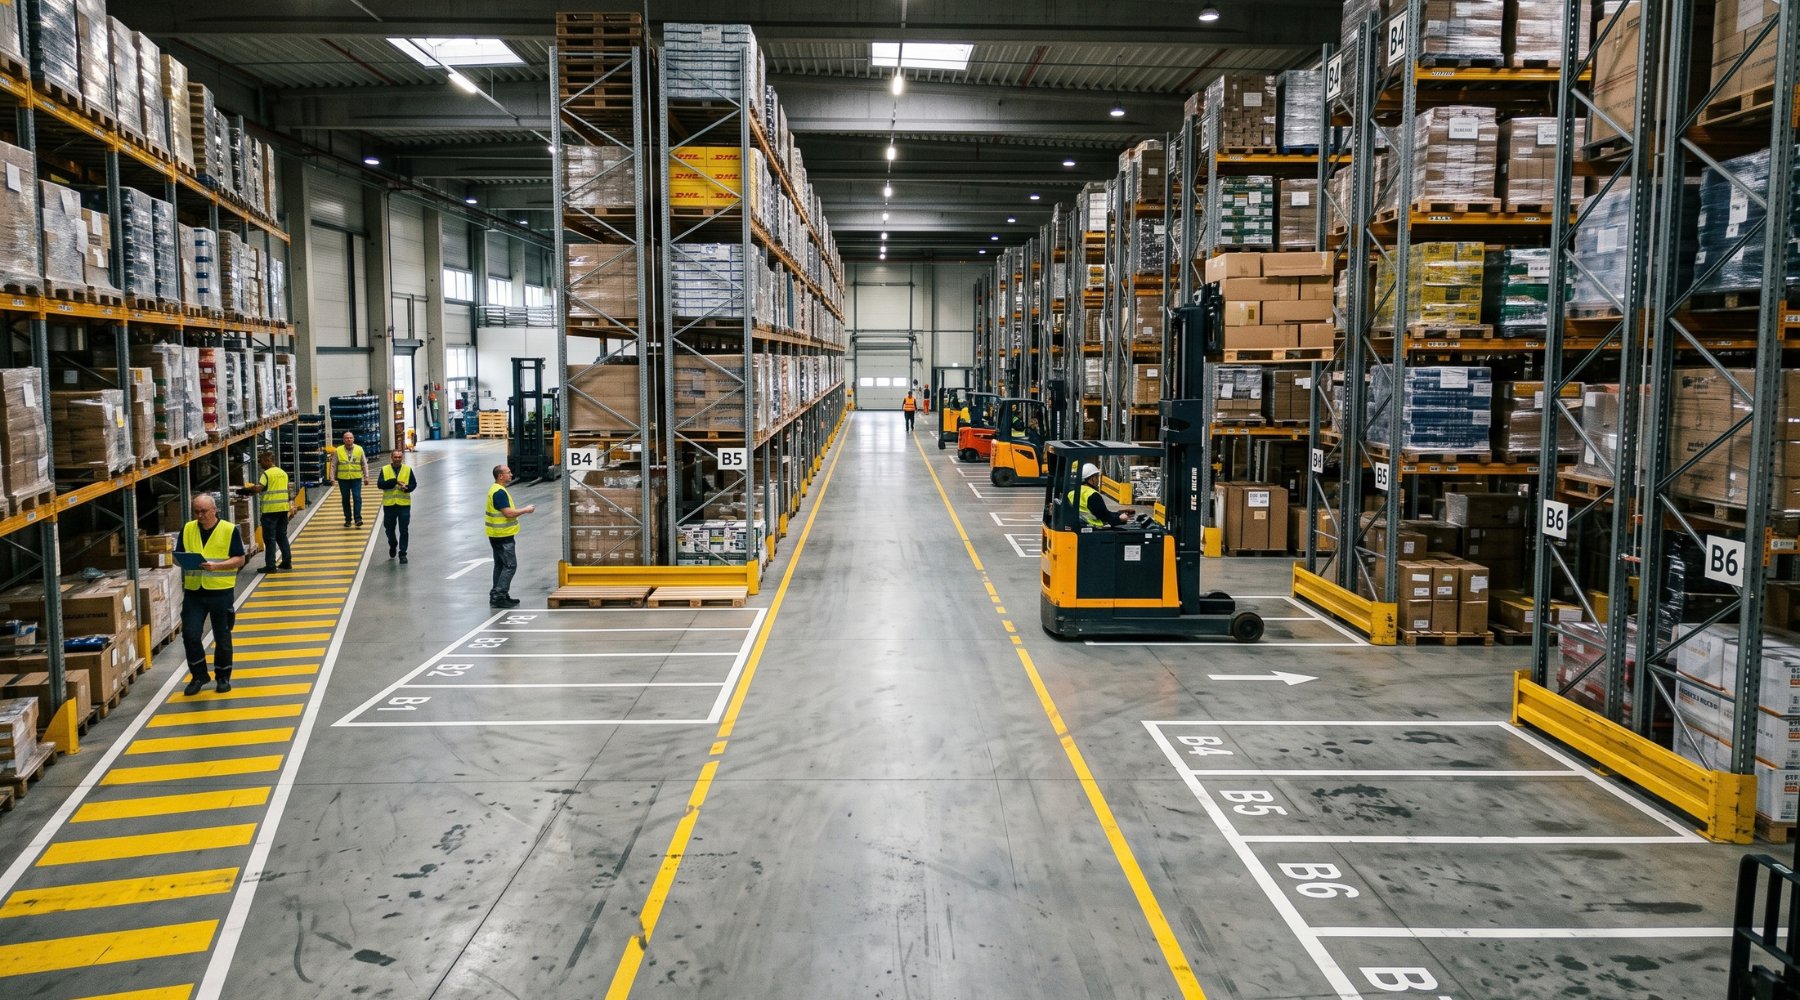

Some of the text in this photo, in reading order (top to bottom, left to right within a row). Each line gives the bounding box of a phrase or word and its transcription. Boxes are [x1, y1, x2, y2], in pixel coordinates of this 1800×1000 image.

[1391, 20, 1404, 55] B4
[1328, 63, 1339, 94] B4
[571, 453, 592, 466] B4
[722, 453, 742, 466] B5
[1377, 468, 1387, 485] B5
[1546, 507, 1564, 530] B6
[1711, 545, 1738, 576] B6
[467, 638, 510, 648] B3
[426, 664, 475, 677] B2
[376, 697, 432, 711] B1
[1176, 735, 1234, 757] B4
[1218, 790, 1288, 817] B5
[1277, 862, 1360, 900] B6
[1359, 967, 1453, 1000] B
